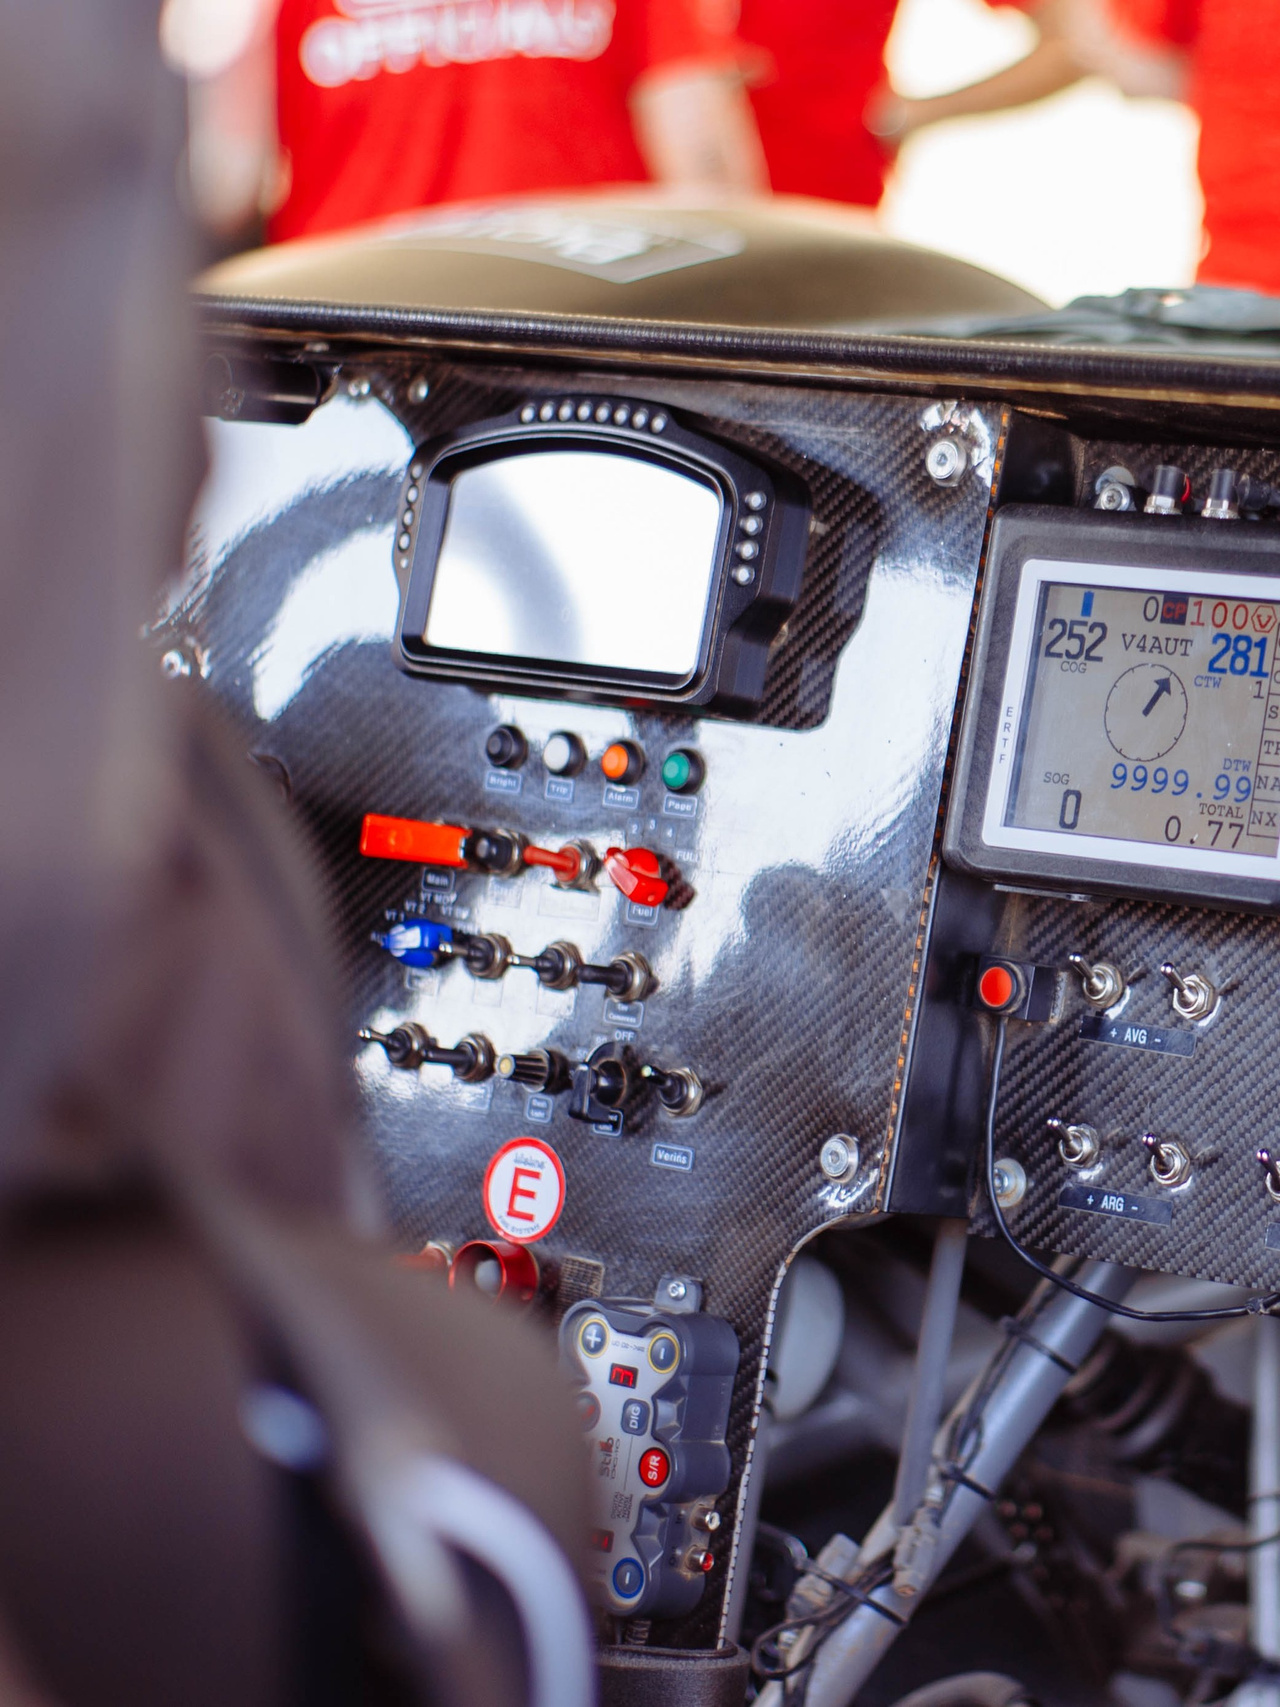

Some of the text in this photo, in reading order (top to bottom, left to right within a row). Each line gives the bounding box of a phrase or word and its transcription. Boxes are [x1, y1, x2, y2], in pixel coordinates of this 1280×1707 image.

[1143, 596, 1159, 622] 0
[1162, 602, 1187, 620] CP
[1190, 600, 1249, 630] 100
[1044, 618, 1108, 662] 252
[1121, 633, 1193, 657] V4AUT
[1207, 632, 1269, 678] 281
[1060, 661, 1087, 673] COG
[1194, 675, 1222, 688] CTW
[1253, 680, 1264, 699] 1
[1222, 758, 1252, 772] DTW
[1043, 771, 1070, 785] SOG
[1111, 762, 1251, 803] 9999.99
[608, 792, 634, 803] Alarm
[668, 800, 692, 812] Page
[1059, 789, 1082, 830] 0
[1199, 802, 1244, 819] TOTAL
[1165, 815, 1244, 849] 0.77
[632, 905, 654, 917] Fuel
[615, 1030, 635, 1042] OFF
[1124, 1027, 1148, 1044] AVG
[507, 1167, 541, 1222] E
[1101, 1194, 1125, 1212] ARG
[630, 1406, 641, 1429] DIG
[648, 1455, 661, 1481] S/R
